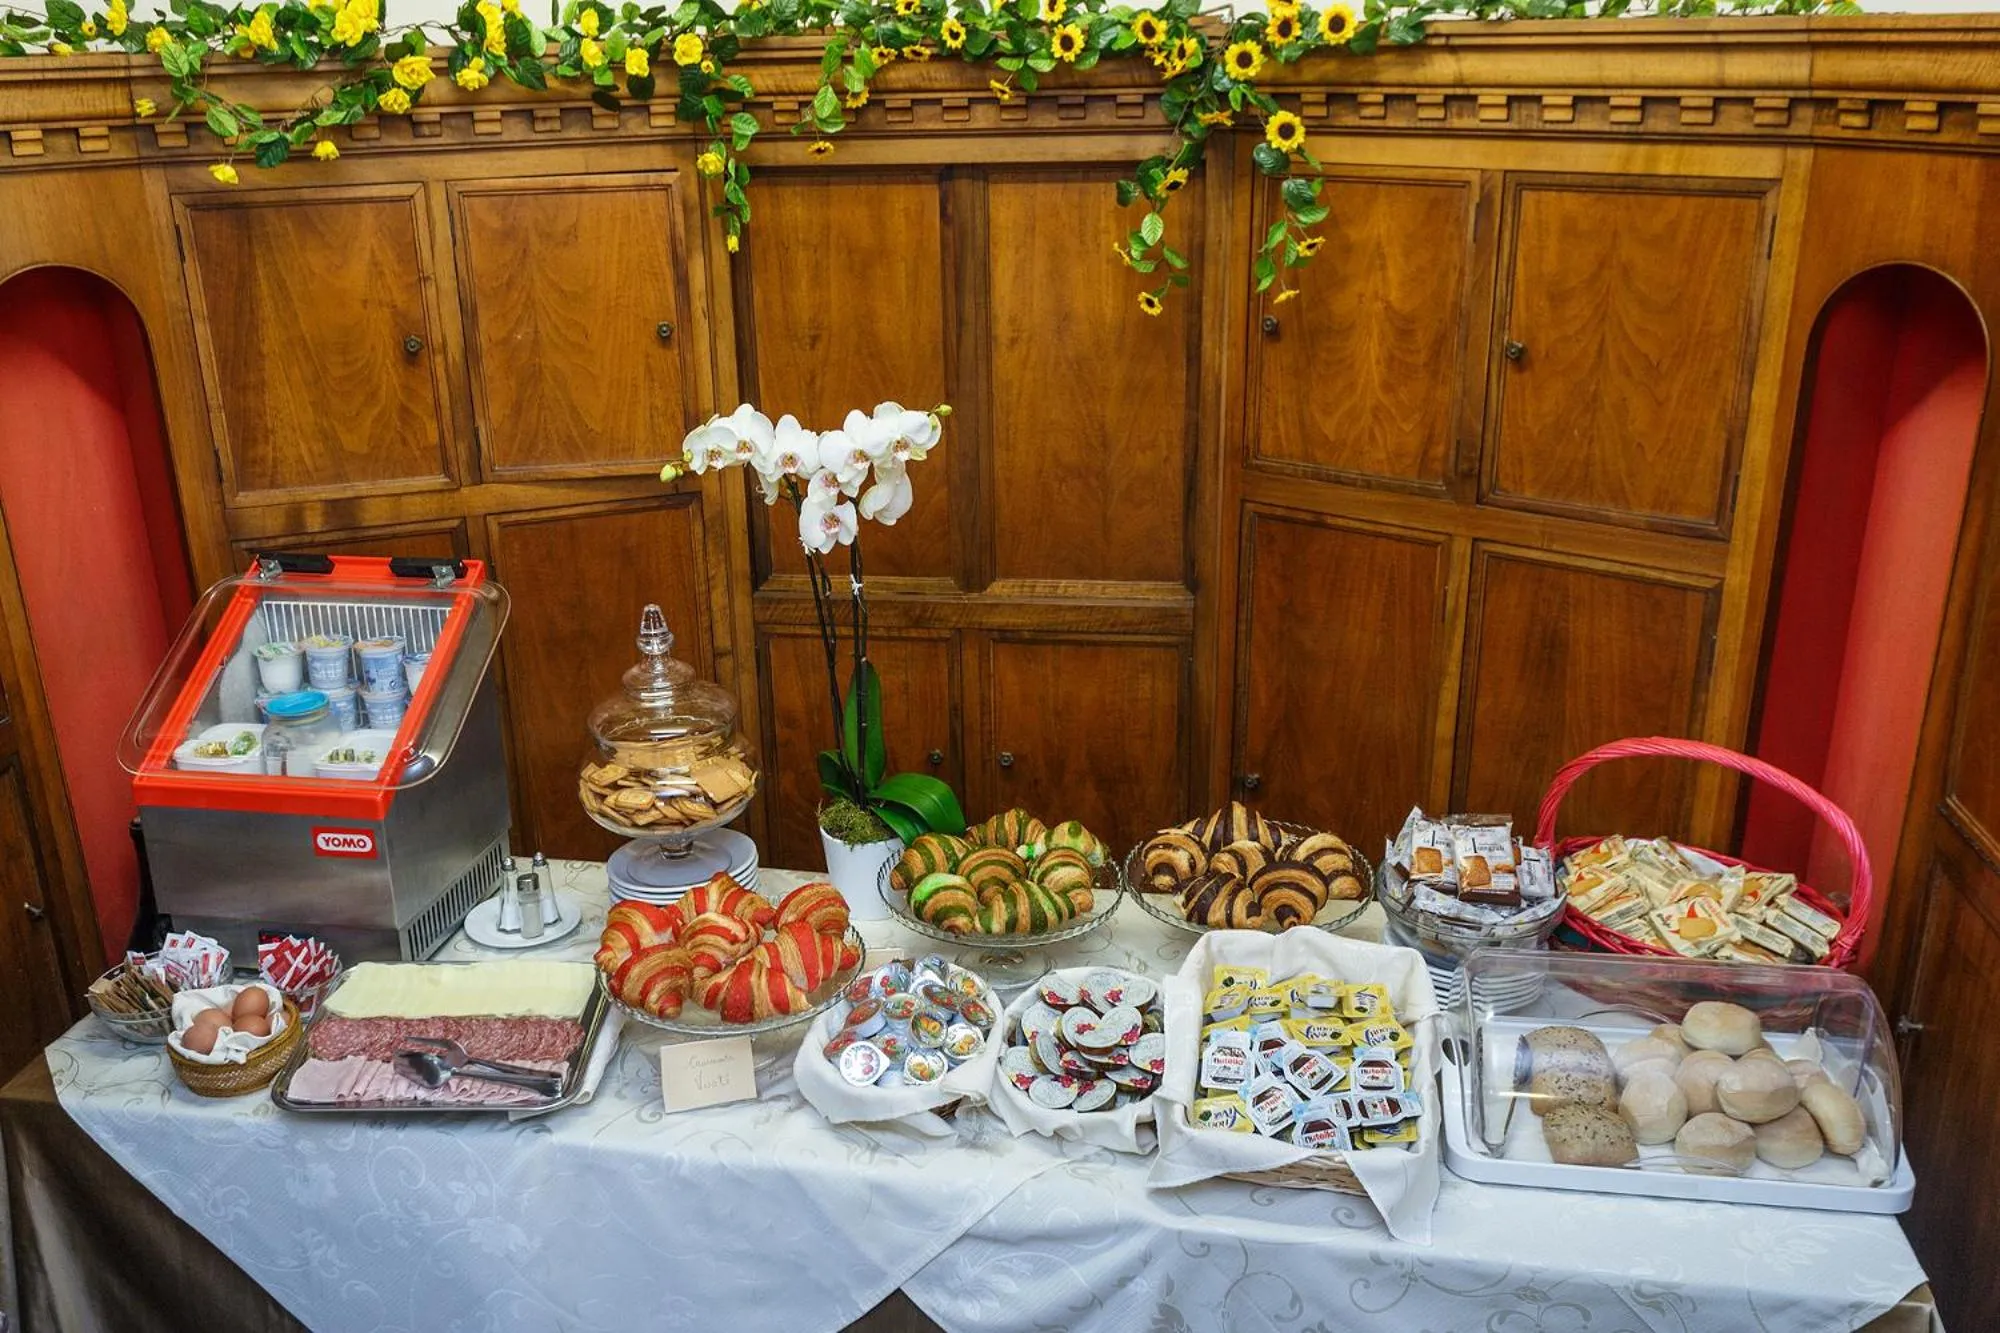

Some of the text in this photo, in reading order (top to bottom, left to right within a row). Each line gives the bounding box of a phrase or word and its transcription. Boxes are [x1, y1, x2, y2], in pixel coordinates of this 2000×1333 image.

[321, 836, 367, 849] YOMO
[1213, 1056, 1243, 1066] nutella
[1297, 1058, 1319, 1078] nutella
[1360, 1068, 1392, 1076] nutella
[1257, 1092, 1285, 1112] nutella
[1305, 1130, 1336, 1144] nutella
